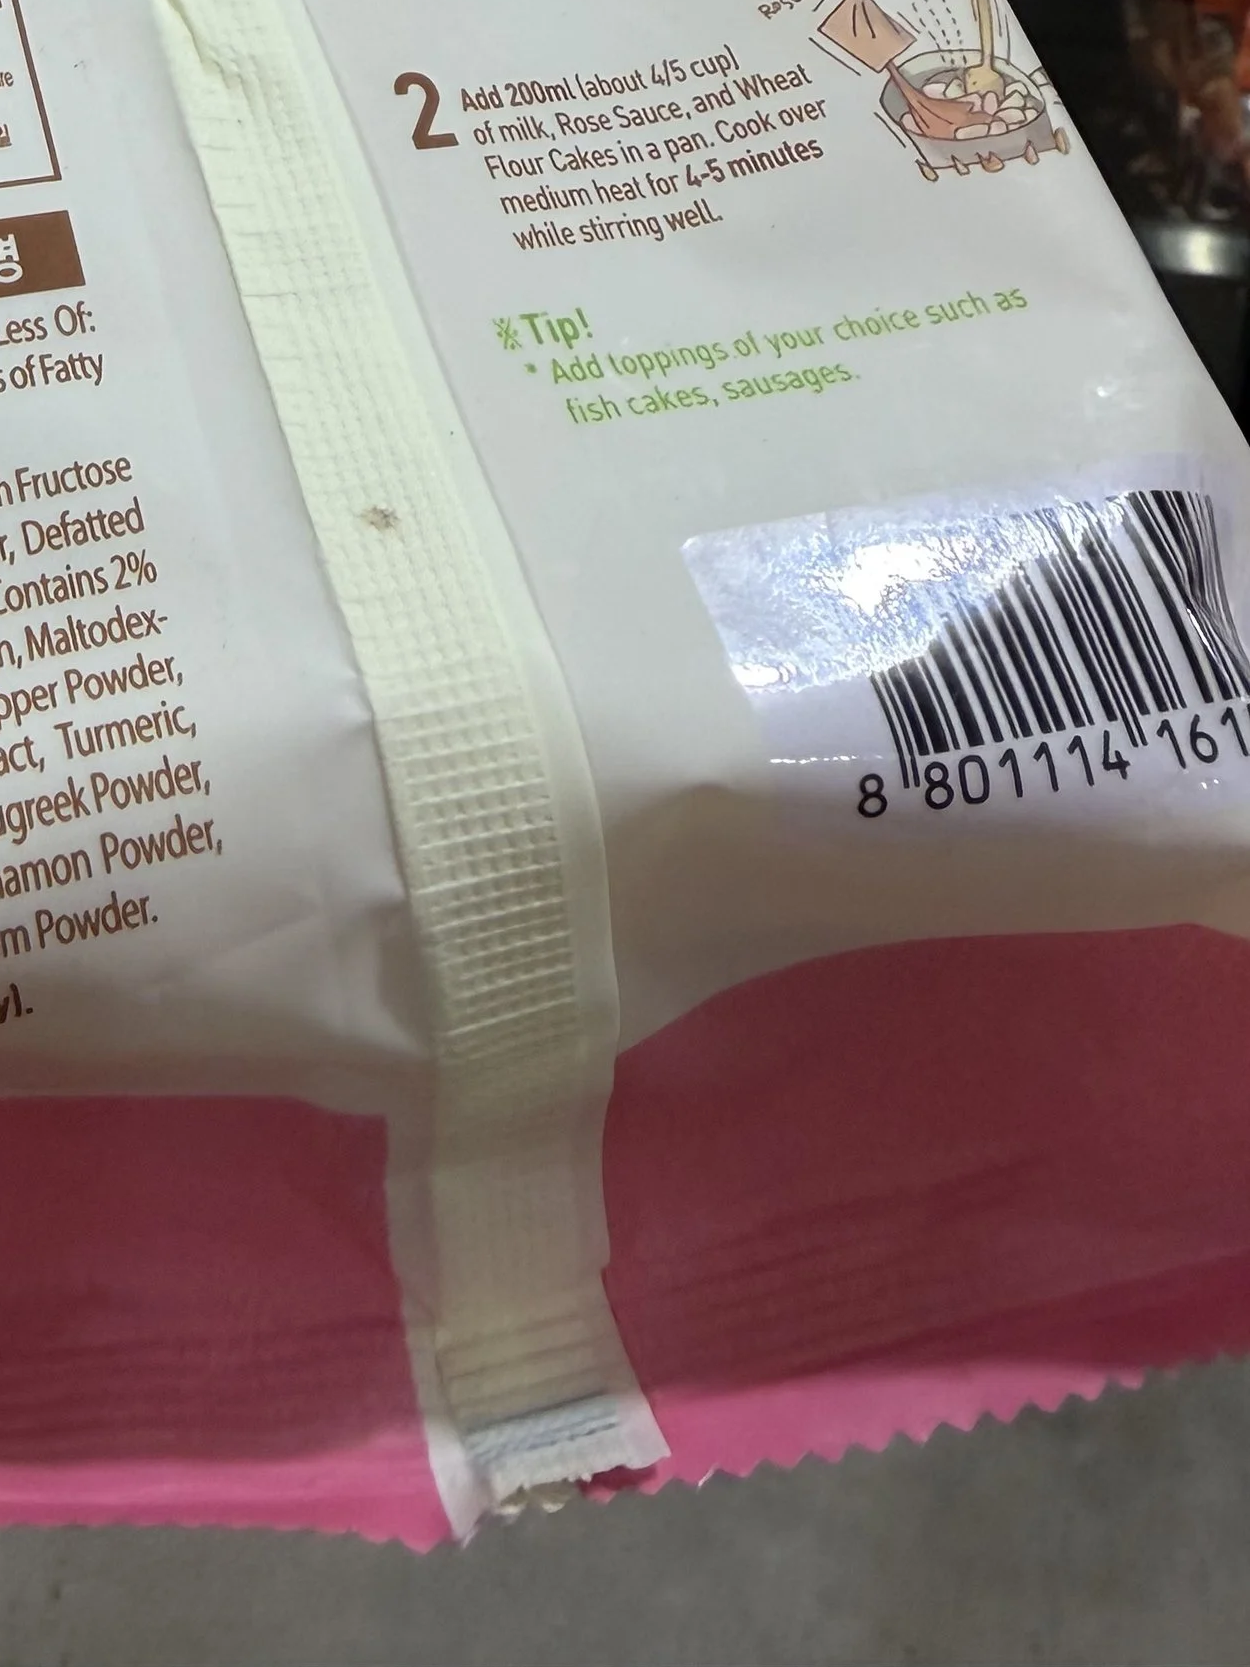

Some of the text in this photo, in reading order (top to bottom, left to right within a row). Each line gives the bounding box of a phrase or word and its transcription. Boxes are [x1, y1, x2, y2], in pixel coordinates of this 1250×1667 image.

[461, 44, 739, 112] Add 200ml (about 4/5 cup)
[392, 72, 459, 150] 2
[500, 140, 824, 215] medium heat for 4-5 minutes
[512, 198, 723, 250] while stirring well.
[54, 300, 96, 337] Of:
[518, 307, 593, 350] Tip!
[551, 288, 1028, 385] Add toppings of your choice such as
[566, 363, 861, 425] fish cakes, sausages.
[857, 773, 888, 817] 8
[923, 729, 1132, 810] 801114
[35, 890, 158, 949] Powder.
